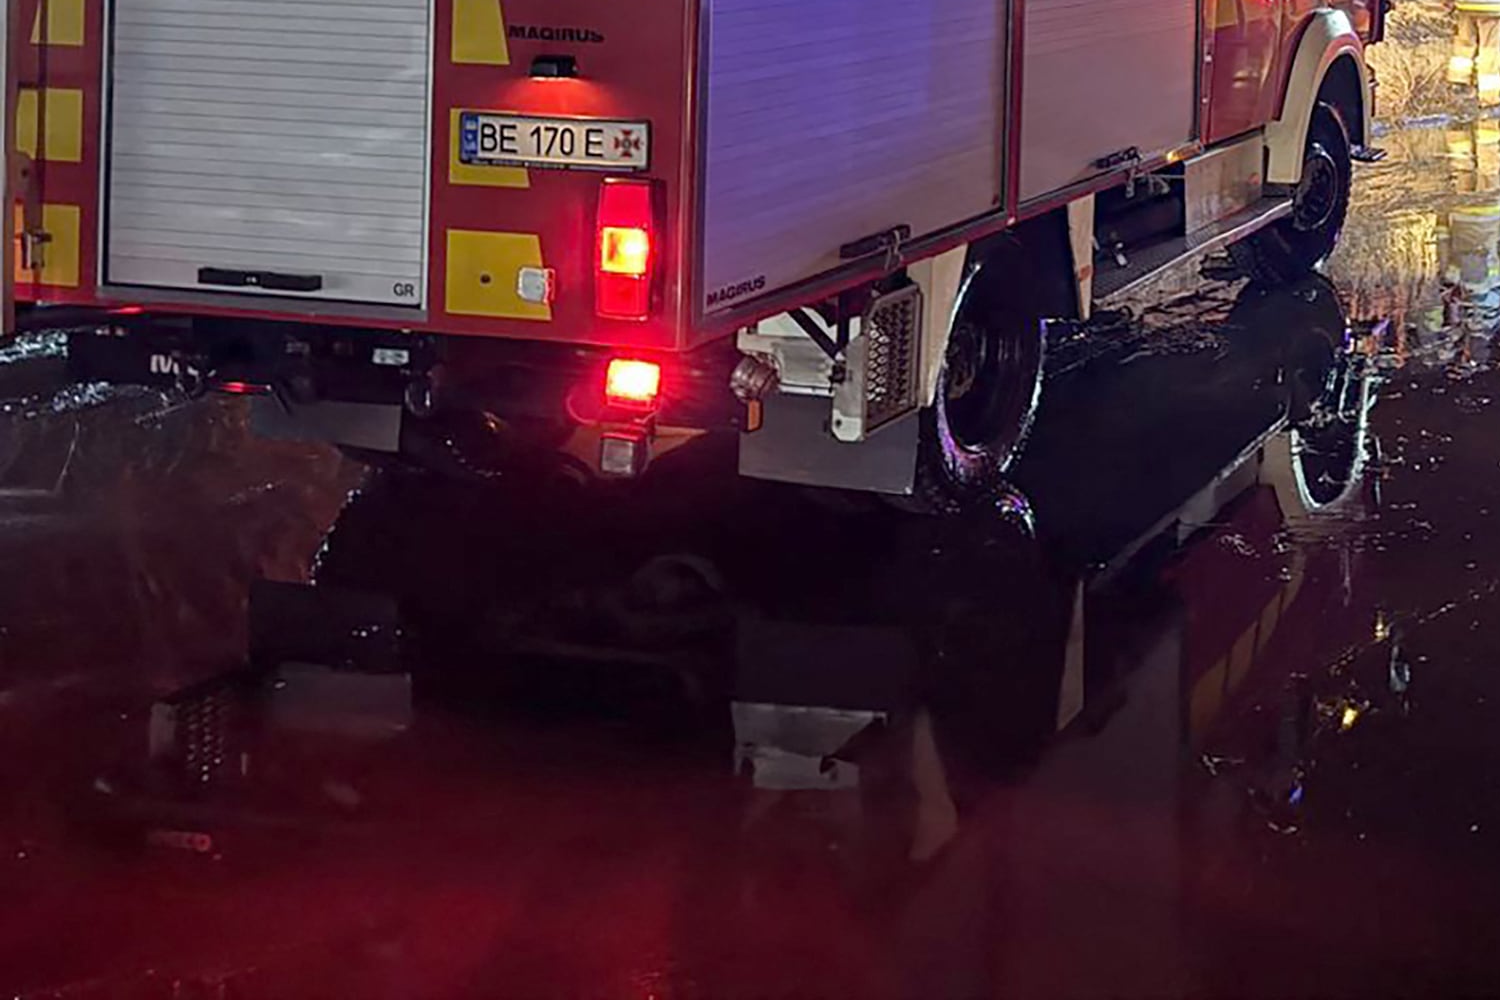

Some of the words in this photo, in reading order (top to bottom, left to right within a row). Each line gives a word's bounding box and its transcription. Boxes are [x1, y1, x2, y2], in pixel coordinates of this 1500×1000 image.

[509, 25, 604, 43] MAGIRUS
[480, 123, 518, 154] BE
[530, 126, 575, 156] 170
[585, 129, 603, 157] E
[393, 282, 415, 297] GR
[707, 274, 766, 306] MAGIRUS
